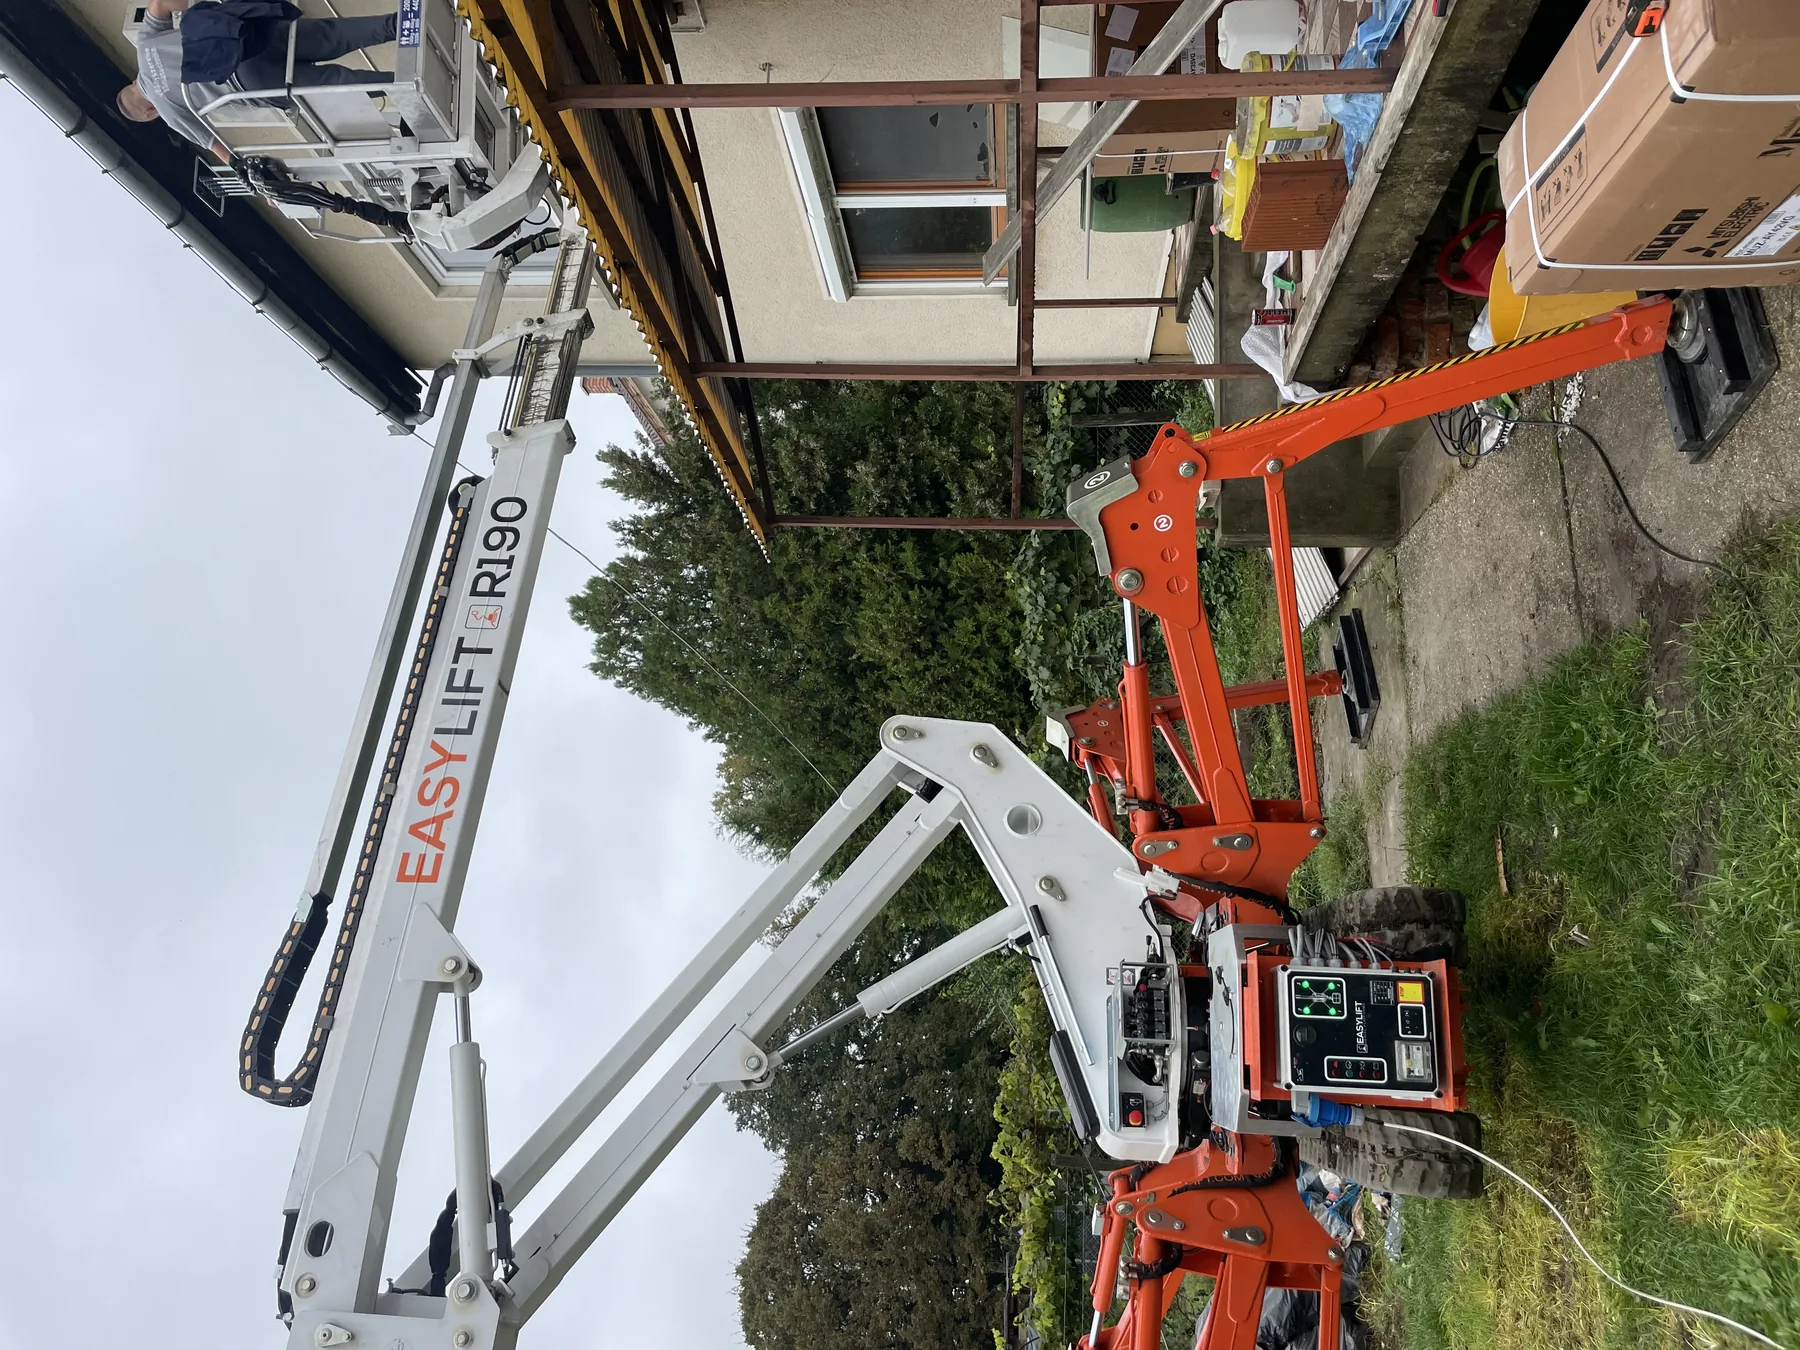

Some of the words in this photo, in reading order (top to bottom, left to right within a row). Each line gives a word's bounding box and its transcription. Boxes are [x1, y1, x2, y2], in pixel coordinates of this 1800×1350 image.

[1706, 196, 1761, 238] MITSUBISHI
[1723, 201, 1770, 238] ELECTRIC
[395, 636, 494, 884] EASYLIFT
[469, 496, 528, 598] R190
[1354, 1000, 1364, 1044] EASYLIFT
